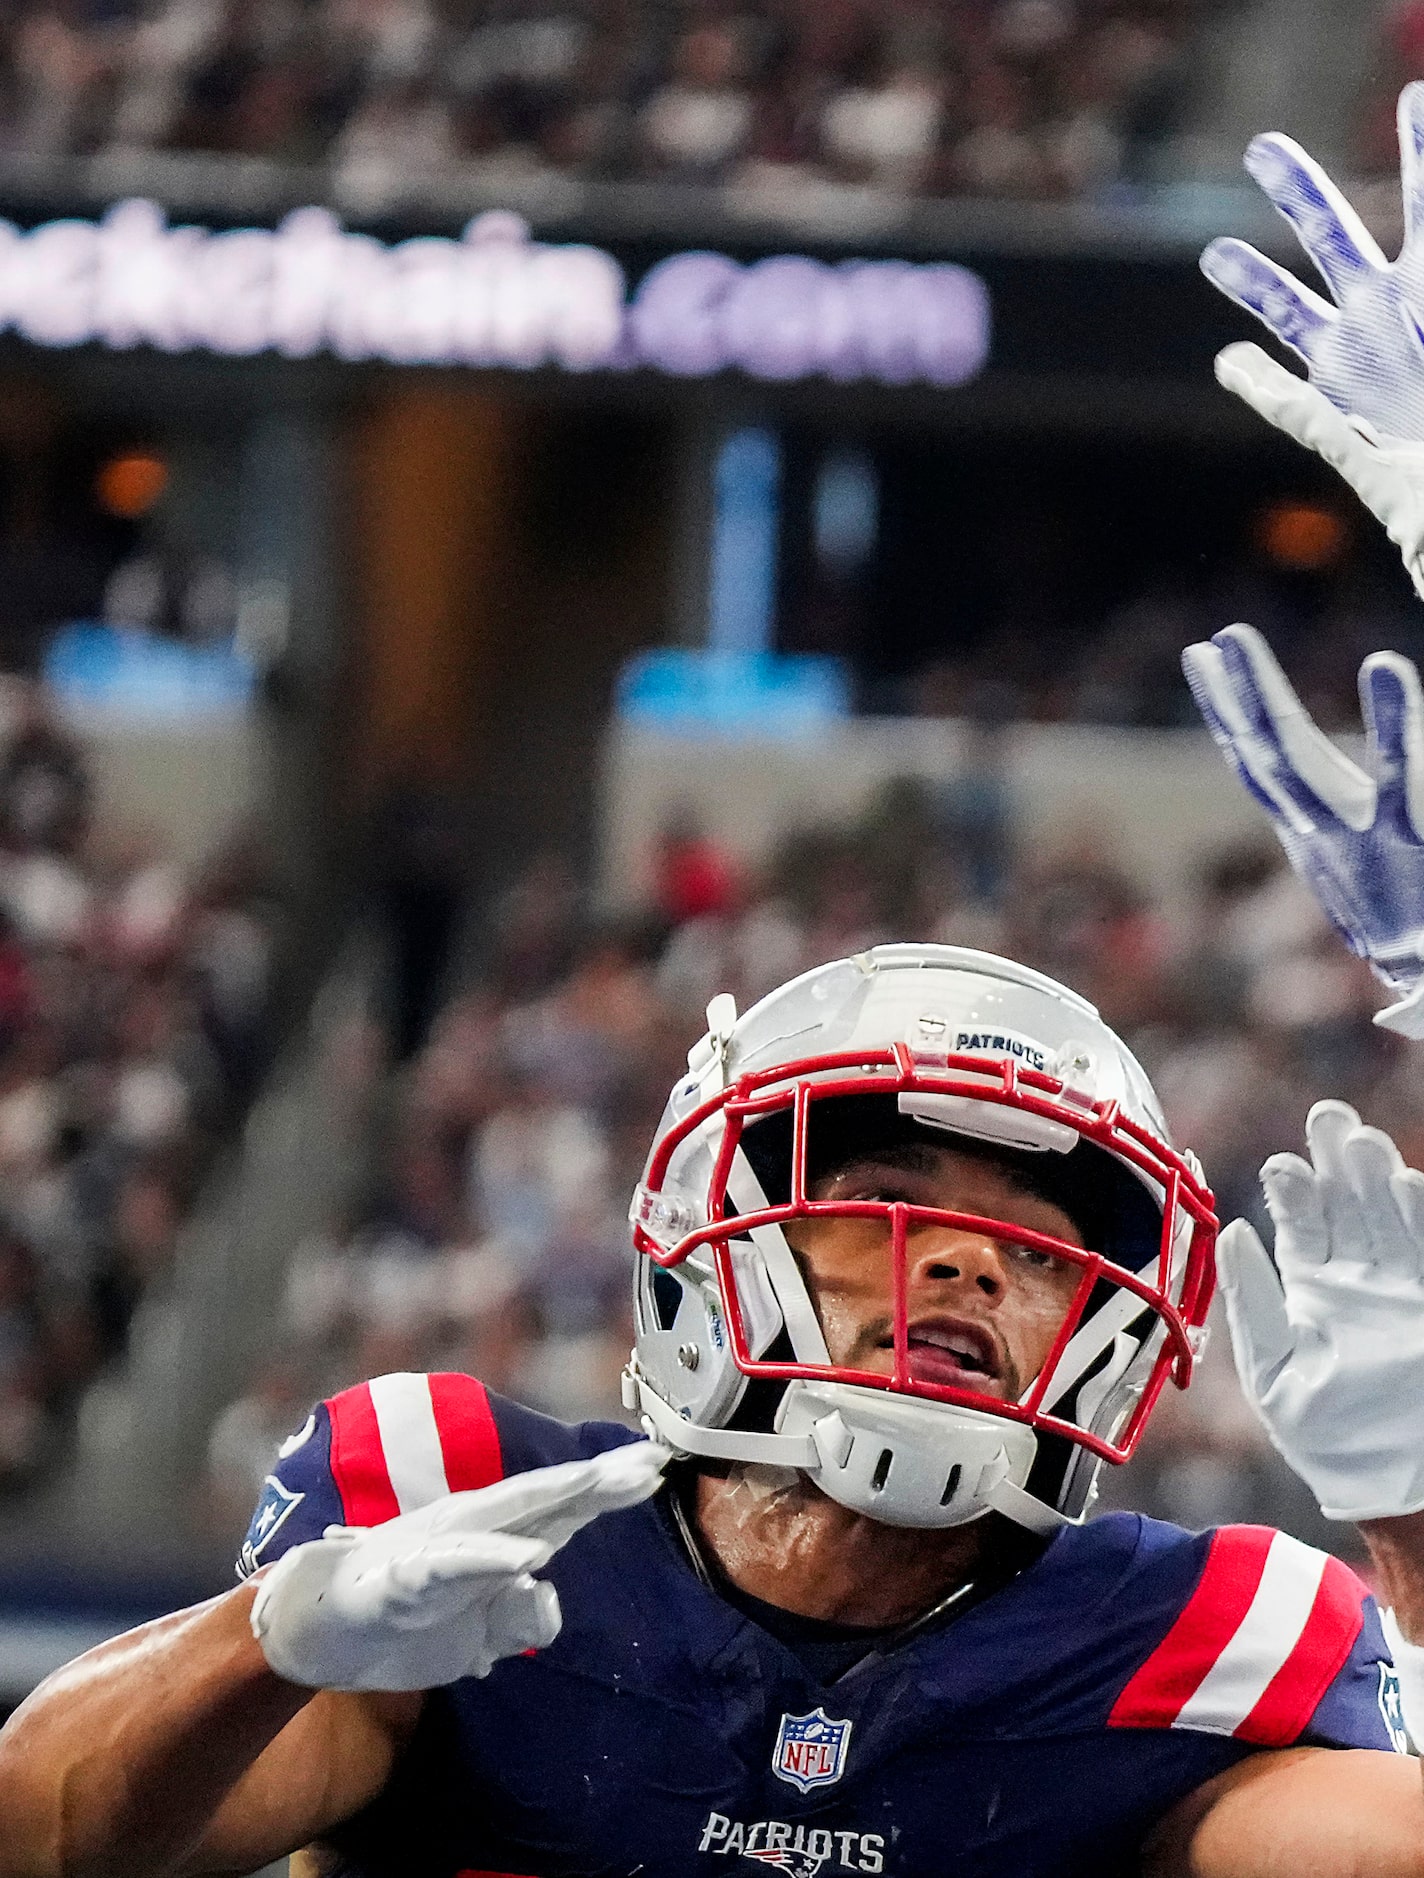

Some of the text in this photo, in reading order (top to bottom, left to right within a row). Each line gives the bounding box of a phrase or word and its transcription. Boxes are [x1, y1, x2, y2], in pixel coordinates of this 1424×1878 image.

[956, 1032, 1045, 1071] PATRIOTS
[783, 1742, 833, 1777] NFL
[698, 1811, 885, 1874] PATRIOTS
